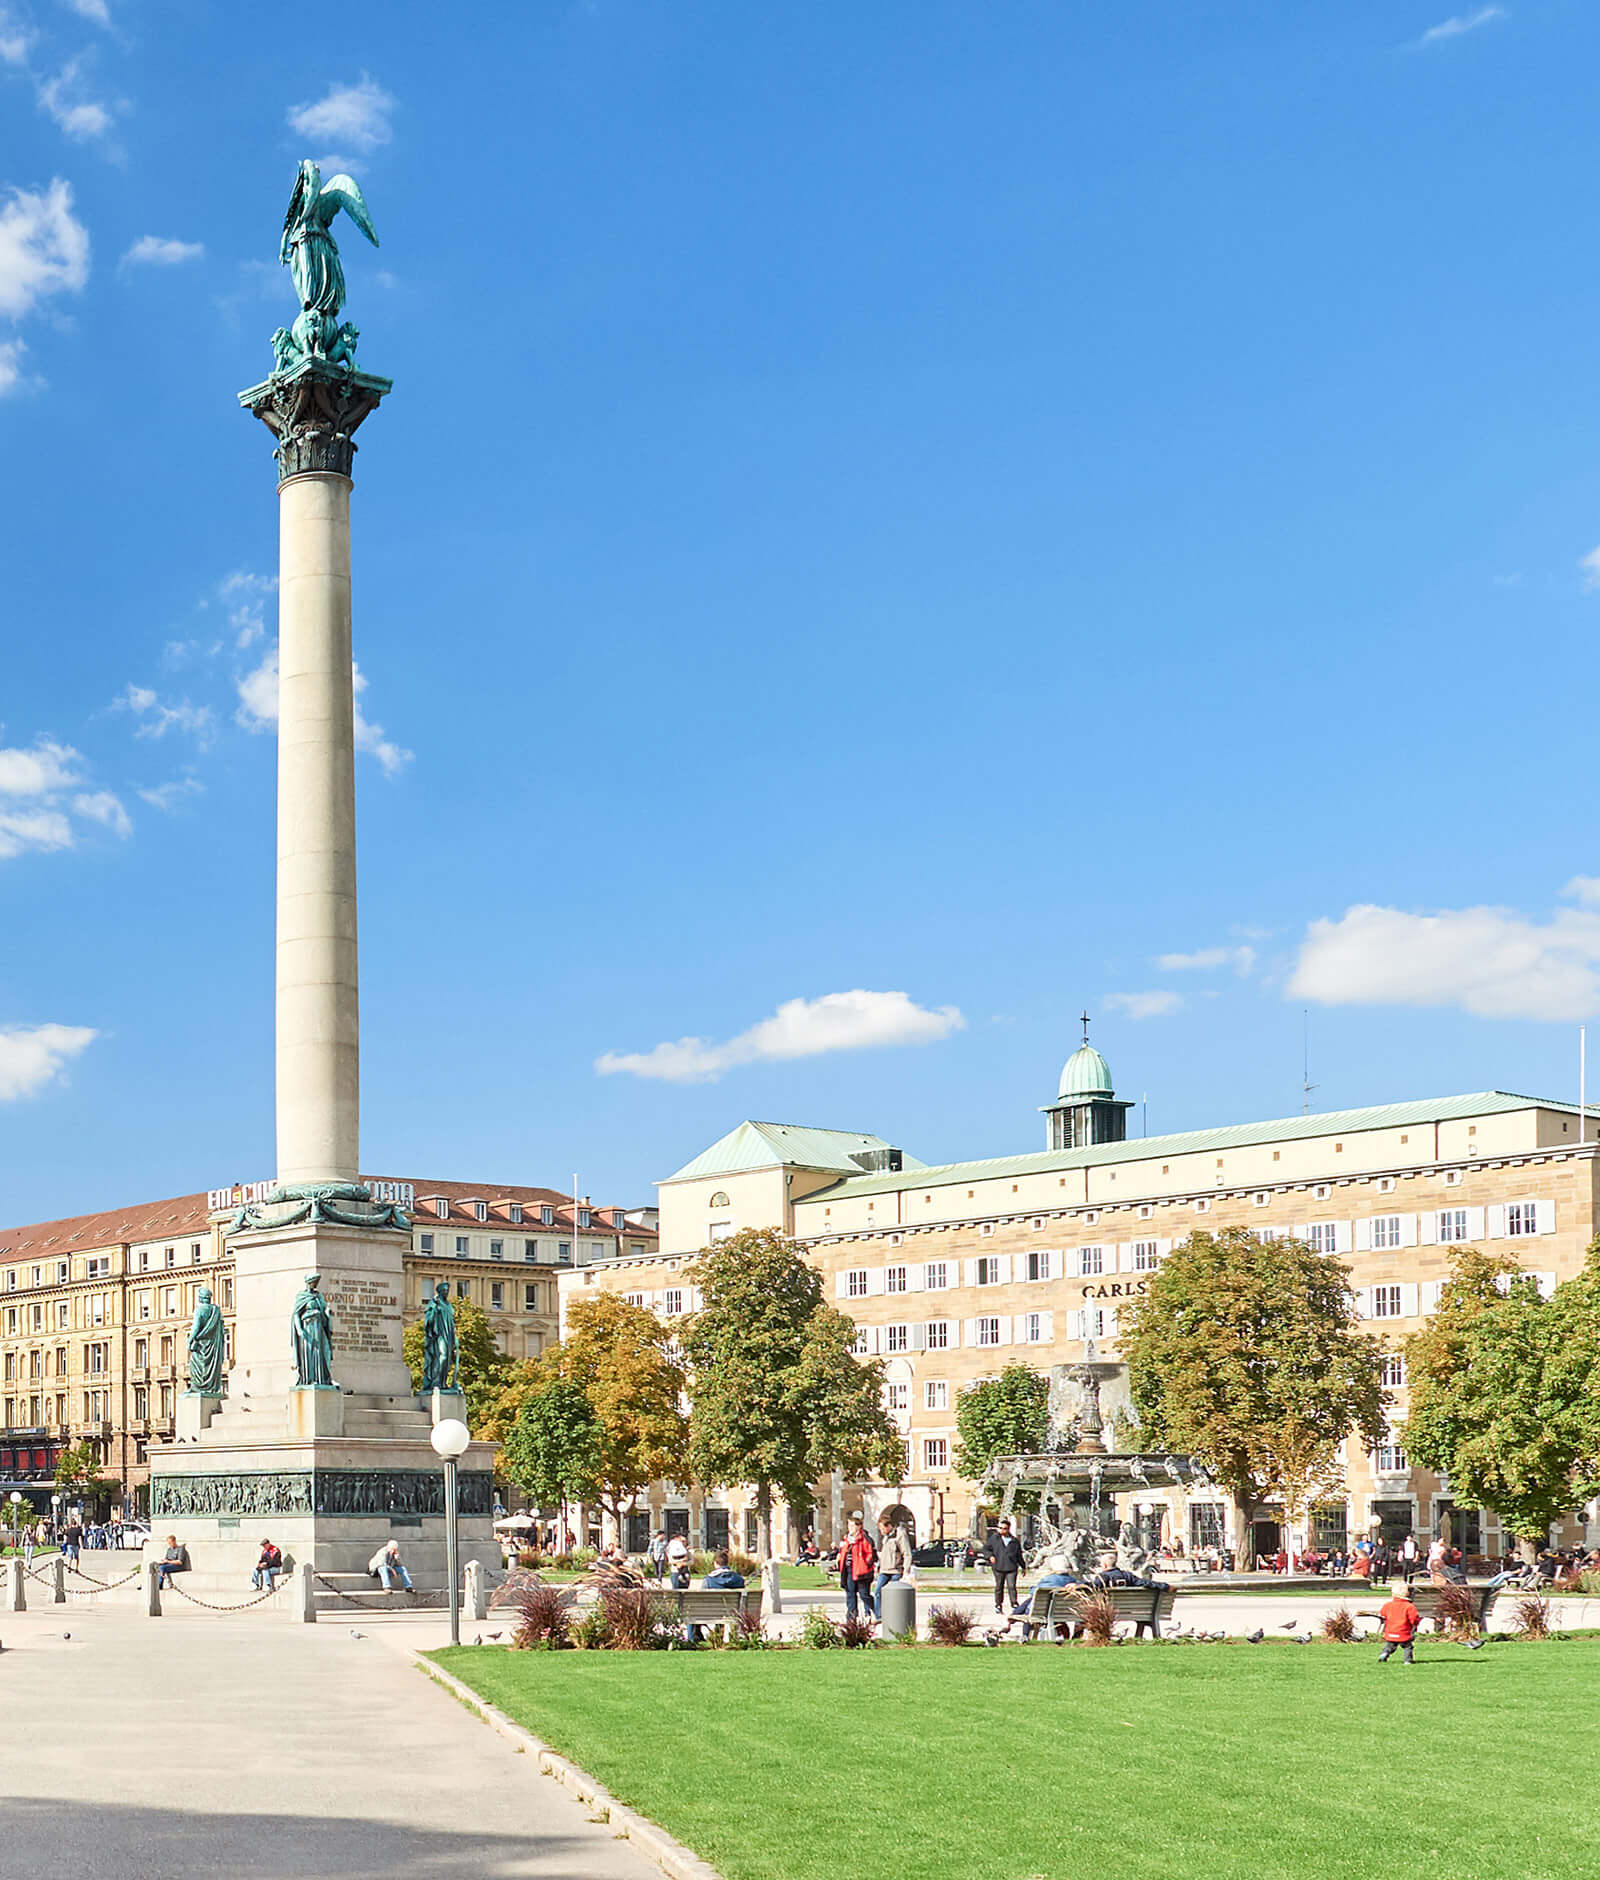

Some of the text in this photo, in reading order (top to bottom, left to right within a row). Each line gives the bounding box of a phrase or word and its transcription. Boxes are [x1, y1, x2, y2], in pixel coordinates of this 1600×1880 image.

[364, 1180, 415, 1201] ORIA
[1082, 1281, 1146, 1298] CARLS
[357, 1294, 397, 1306] WILHELM
